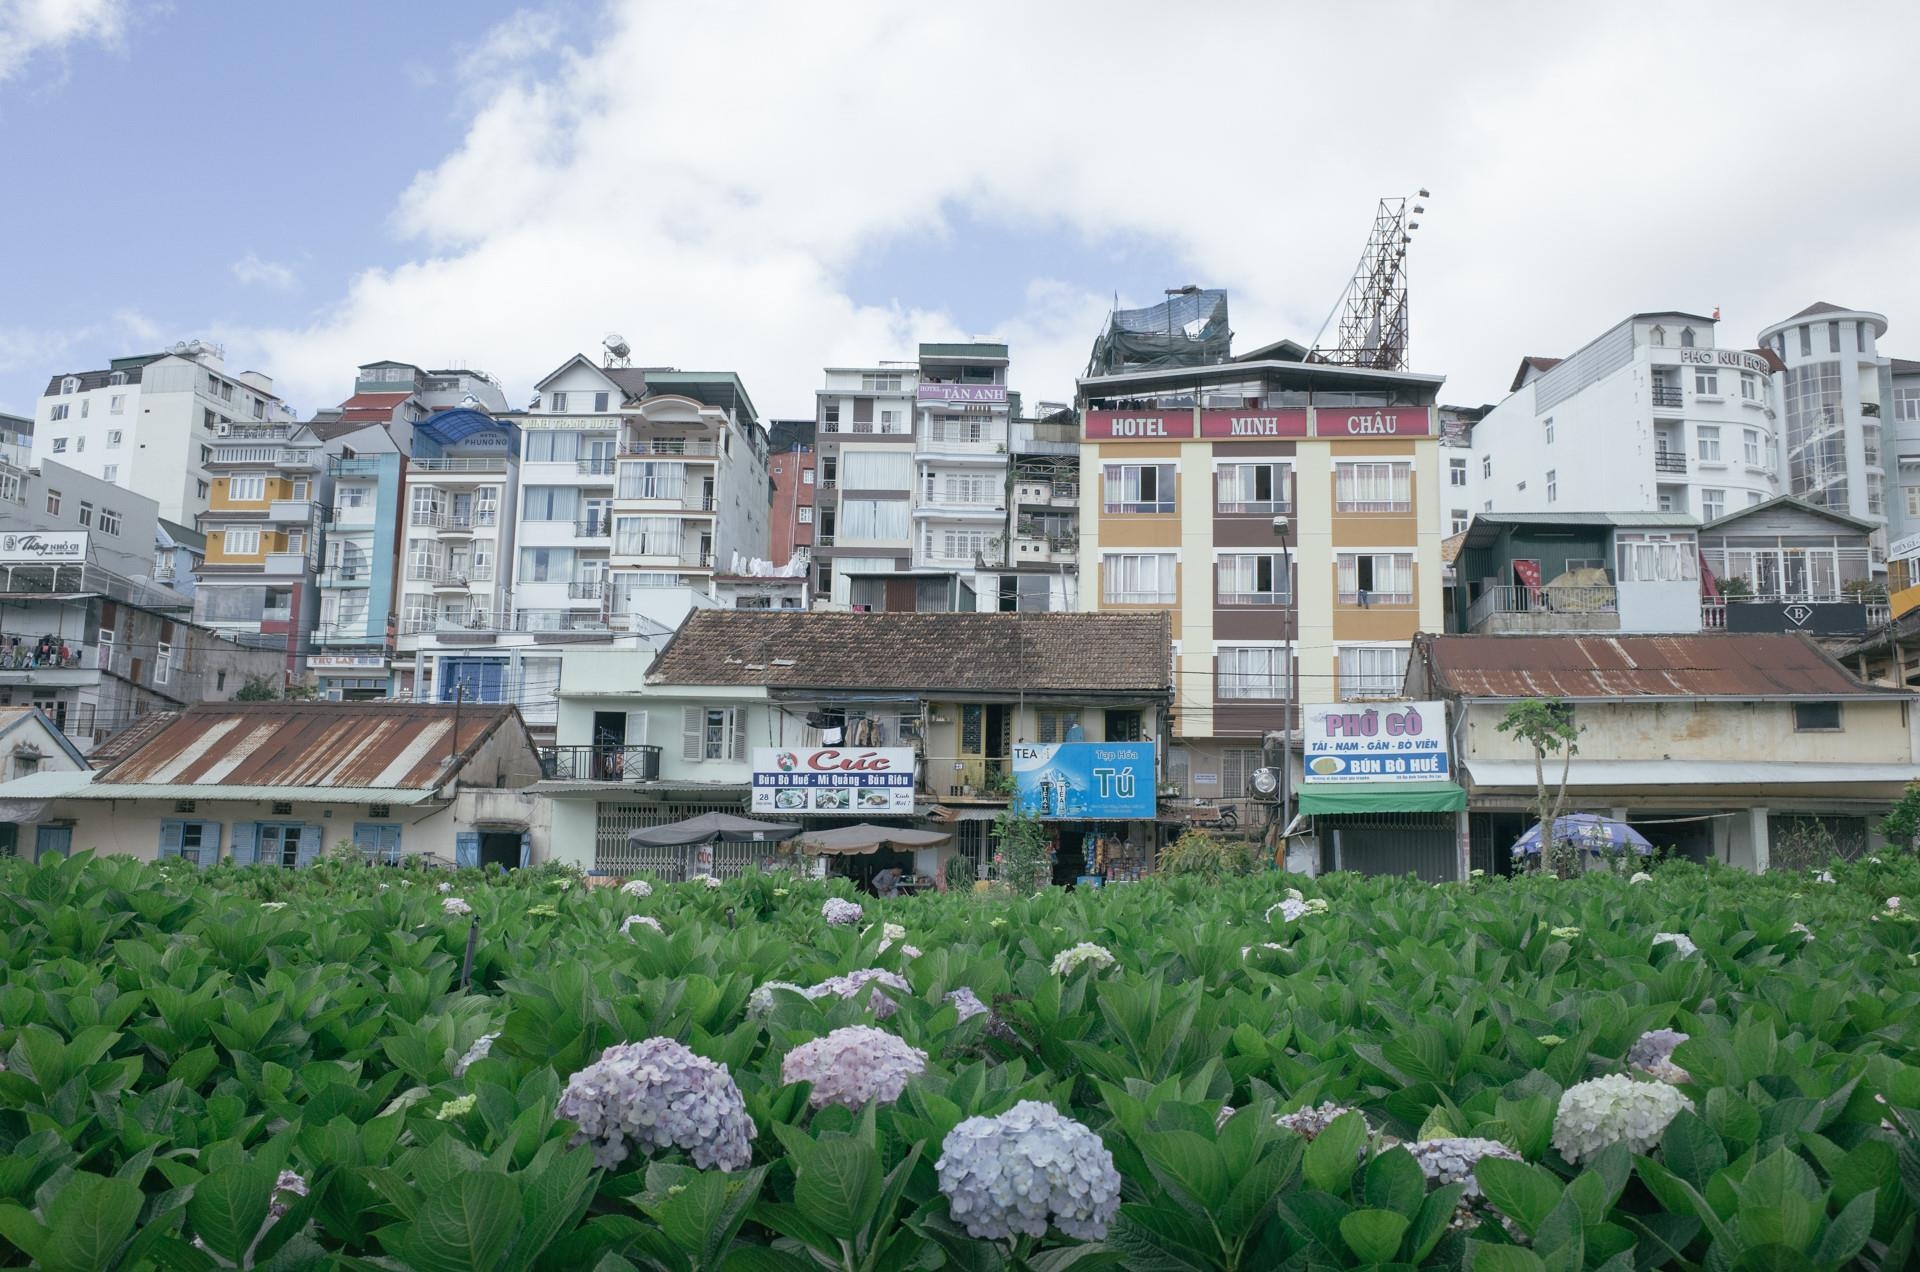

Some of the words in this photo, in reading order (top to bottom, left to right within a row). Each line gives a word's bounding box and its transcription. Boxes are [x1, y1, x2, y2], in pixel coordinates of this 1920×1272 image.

[1743, 355, 1769, 376] HOTE
[943, 386, 971, 399] TÂN
[974, 389, 1004, 400] ANH
[591, 418, 619, 429] HOTEL
[1111, 418, 1167, 436] HOTEL
[1230, 417, 1278, 436] MINH
[1347, 411, 1397, 434] CHÂU
[1794, 608, 1804, 619] B
[1325, 708, 1379, 737] PHỞ
[1312, 741, 1328, 751] TÁI
[807, 750, 891, 771] Cúc
[1014, 748, 1038, 759] TEA
[1095, 750, 1115, 762] Tạp
[1117, 750, 1138, 760] Hóa
[1350, 757, 1381, 773] BÚN
[1385, 756, 1406, 773] BÒ
[1409, 754, 1439, 772] HUẾ
[758, 774, 775, 785] Bún
[778, 773, 789, 785] Bò
[792, 773, 810, 785] Huế
[832, 773, 860, 787] Quảng
[868, 774, 885, 785] Bún
[887, 774, 909, 785] Riêu
[1093, 766, 1135, 798] Tú
[759, 793, 769, 801] 28
